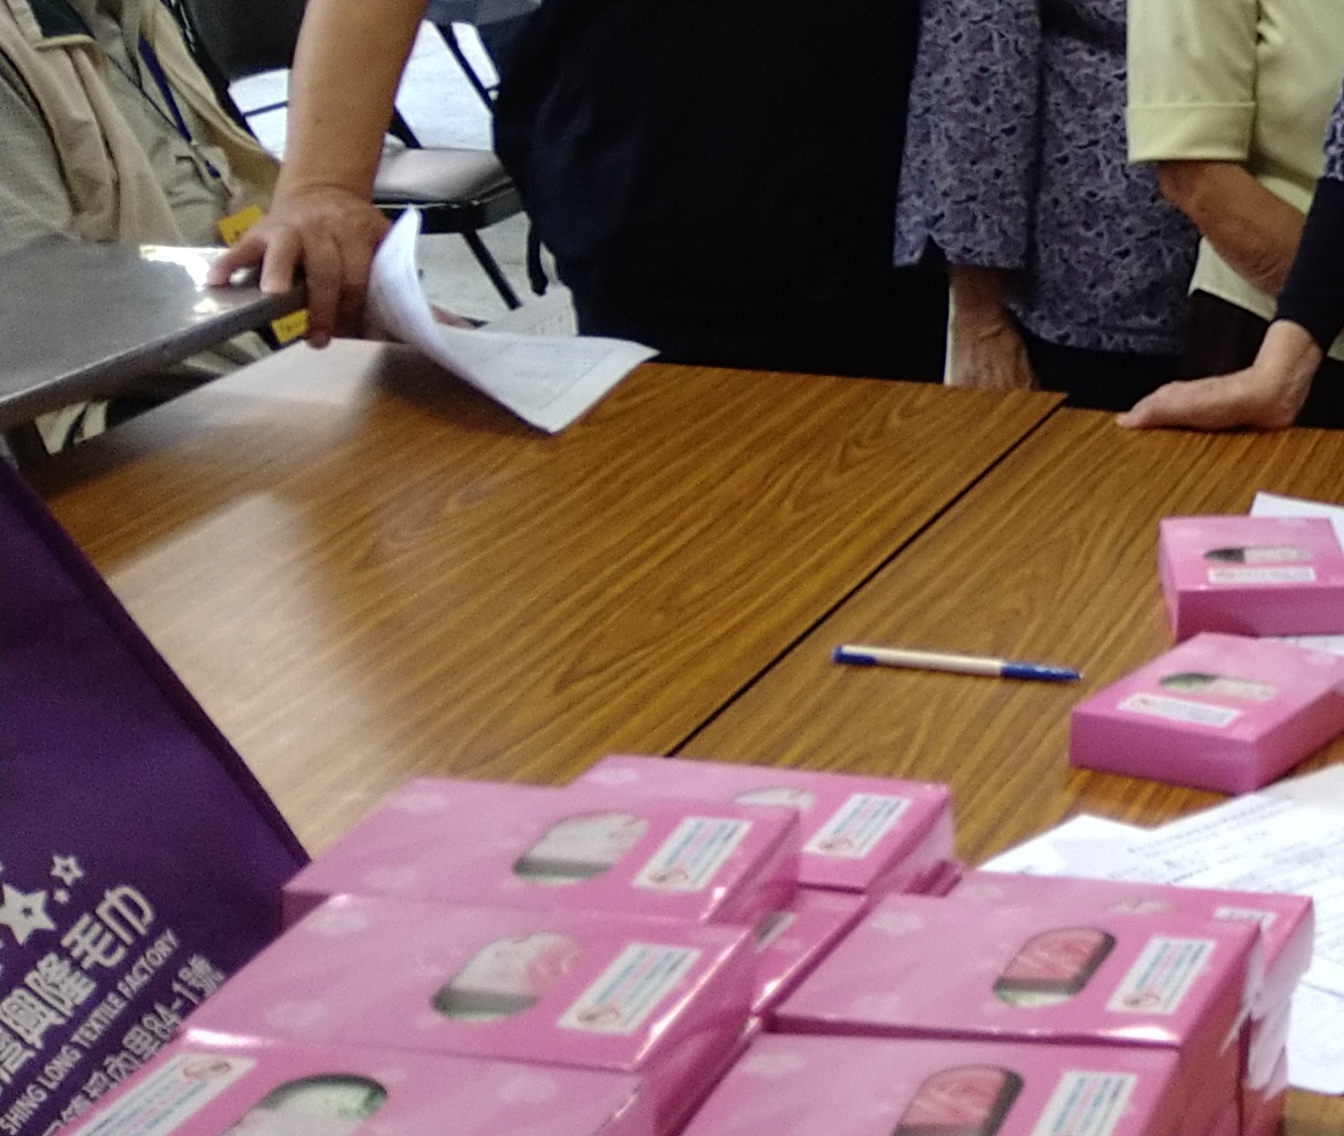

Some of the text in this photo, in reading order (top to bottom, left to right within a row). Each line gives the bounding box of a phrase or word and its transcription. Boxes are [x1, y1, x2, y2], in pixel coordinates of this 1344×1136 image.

[0, 927, 181, 1136] SHING LONG TEXTILE FACTORY
